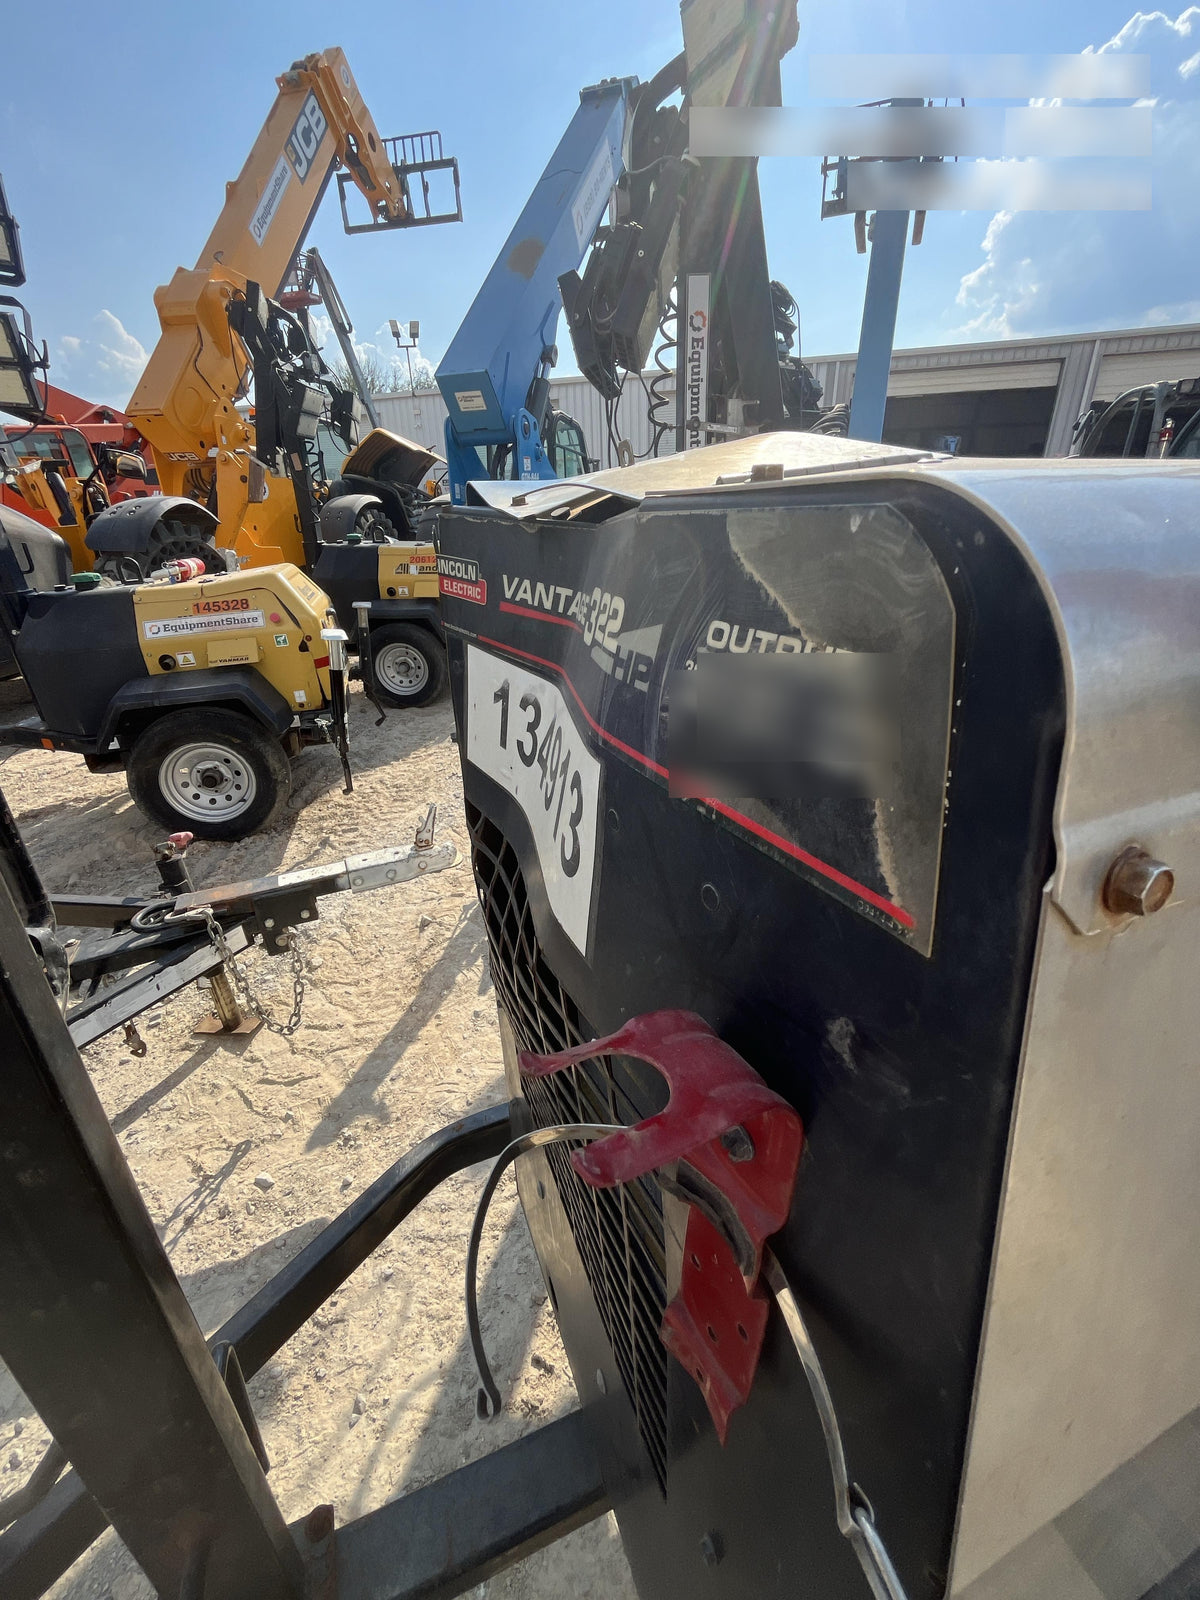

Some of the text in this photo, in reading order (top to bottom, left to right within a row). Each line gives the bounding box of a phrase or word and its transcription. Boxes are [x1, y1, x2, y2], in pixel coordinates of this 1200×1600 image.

[291, 94, 327, 178] JCB
[257, 164, 289, 230] EquipmentShare
[169, 452, 200, 461] JCB
[437, 559, 476, 581] INCOLN
[443, 579, 481, 599] ELECTRIC
[193, 598, 250, 614] 145328
[502, 574, 625, 654] VANTAGE 322
[163, 615, 259, 633] EquipmentShare
[493, 678, 584, 878] 134913
